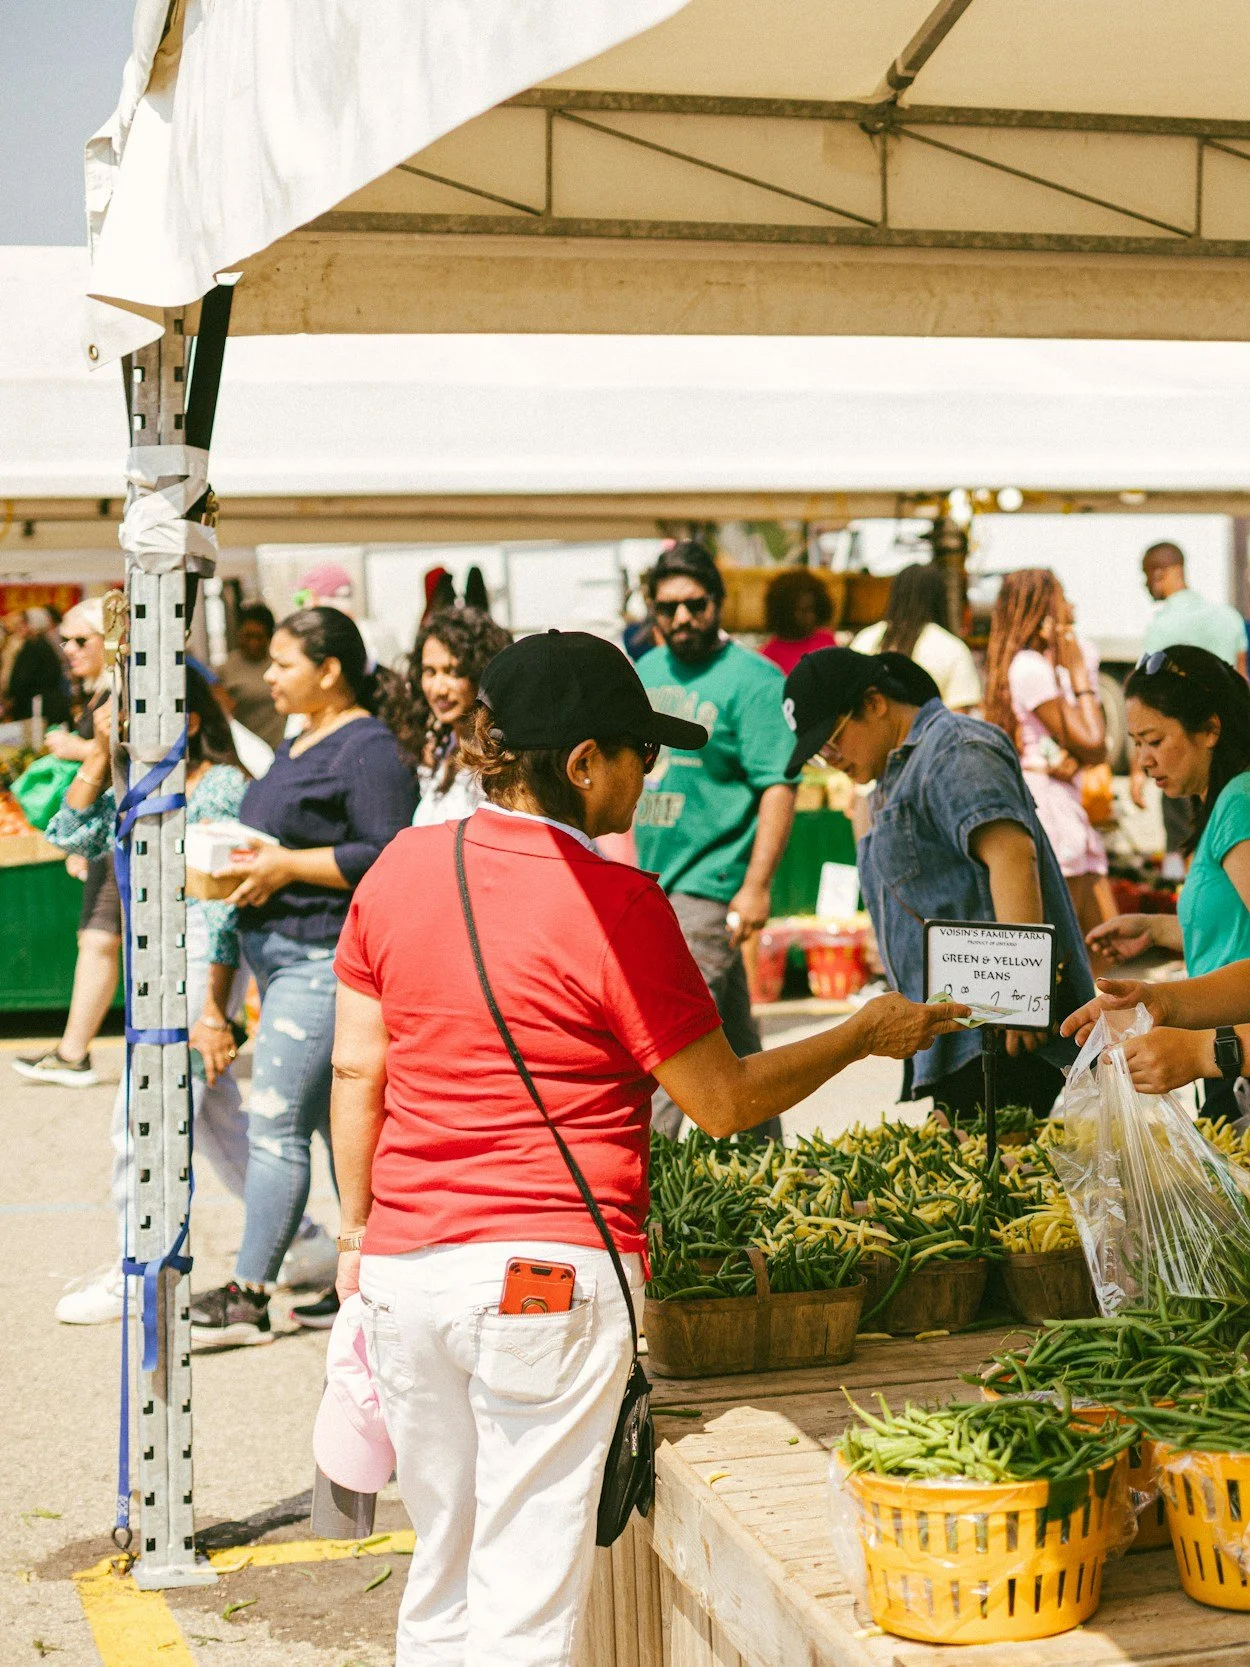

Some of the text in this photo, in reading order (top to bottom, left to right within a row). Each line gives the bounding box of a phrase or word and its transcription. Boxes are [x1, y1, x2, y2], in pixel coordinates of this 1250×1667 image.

[940, 928, 1045, 940] VOISIN'S FAMILY FARM
[942, 953, 1043, 967] GREEN & YELLOW
[973, 970, 1011, 981] BEANS
[1011, 989, 1026, 1001] for
